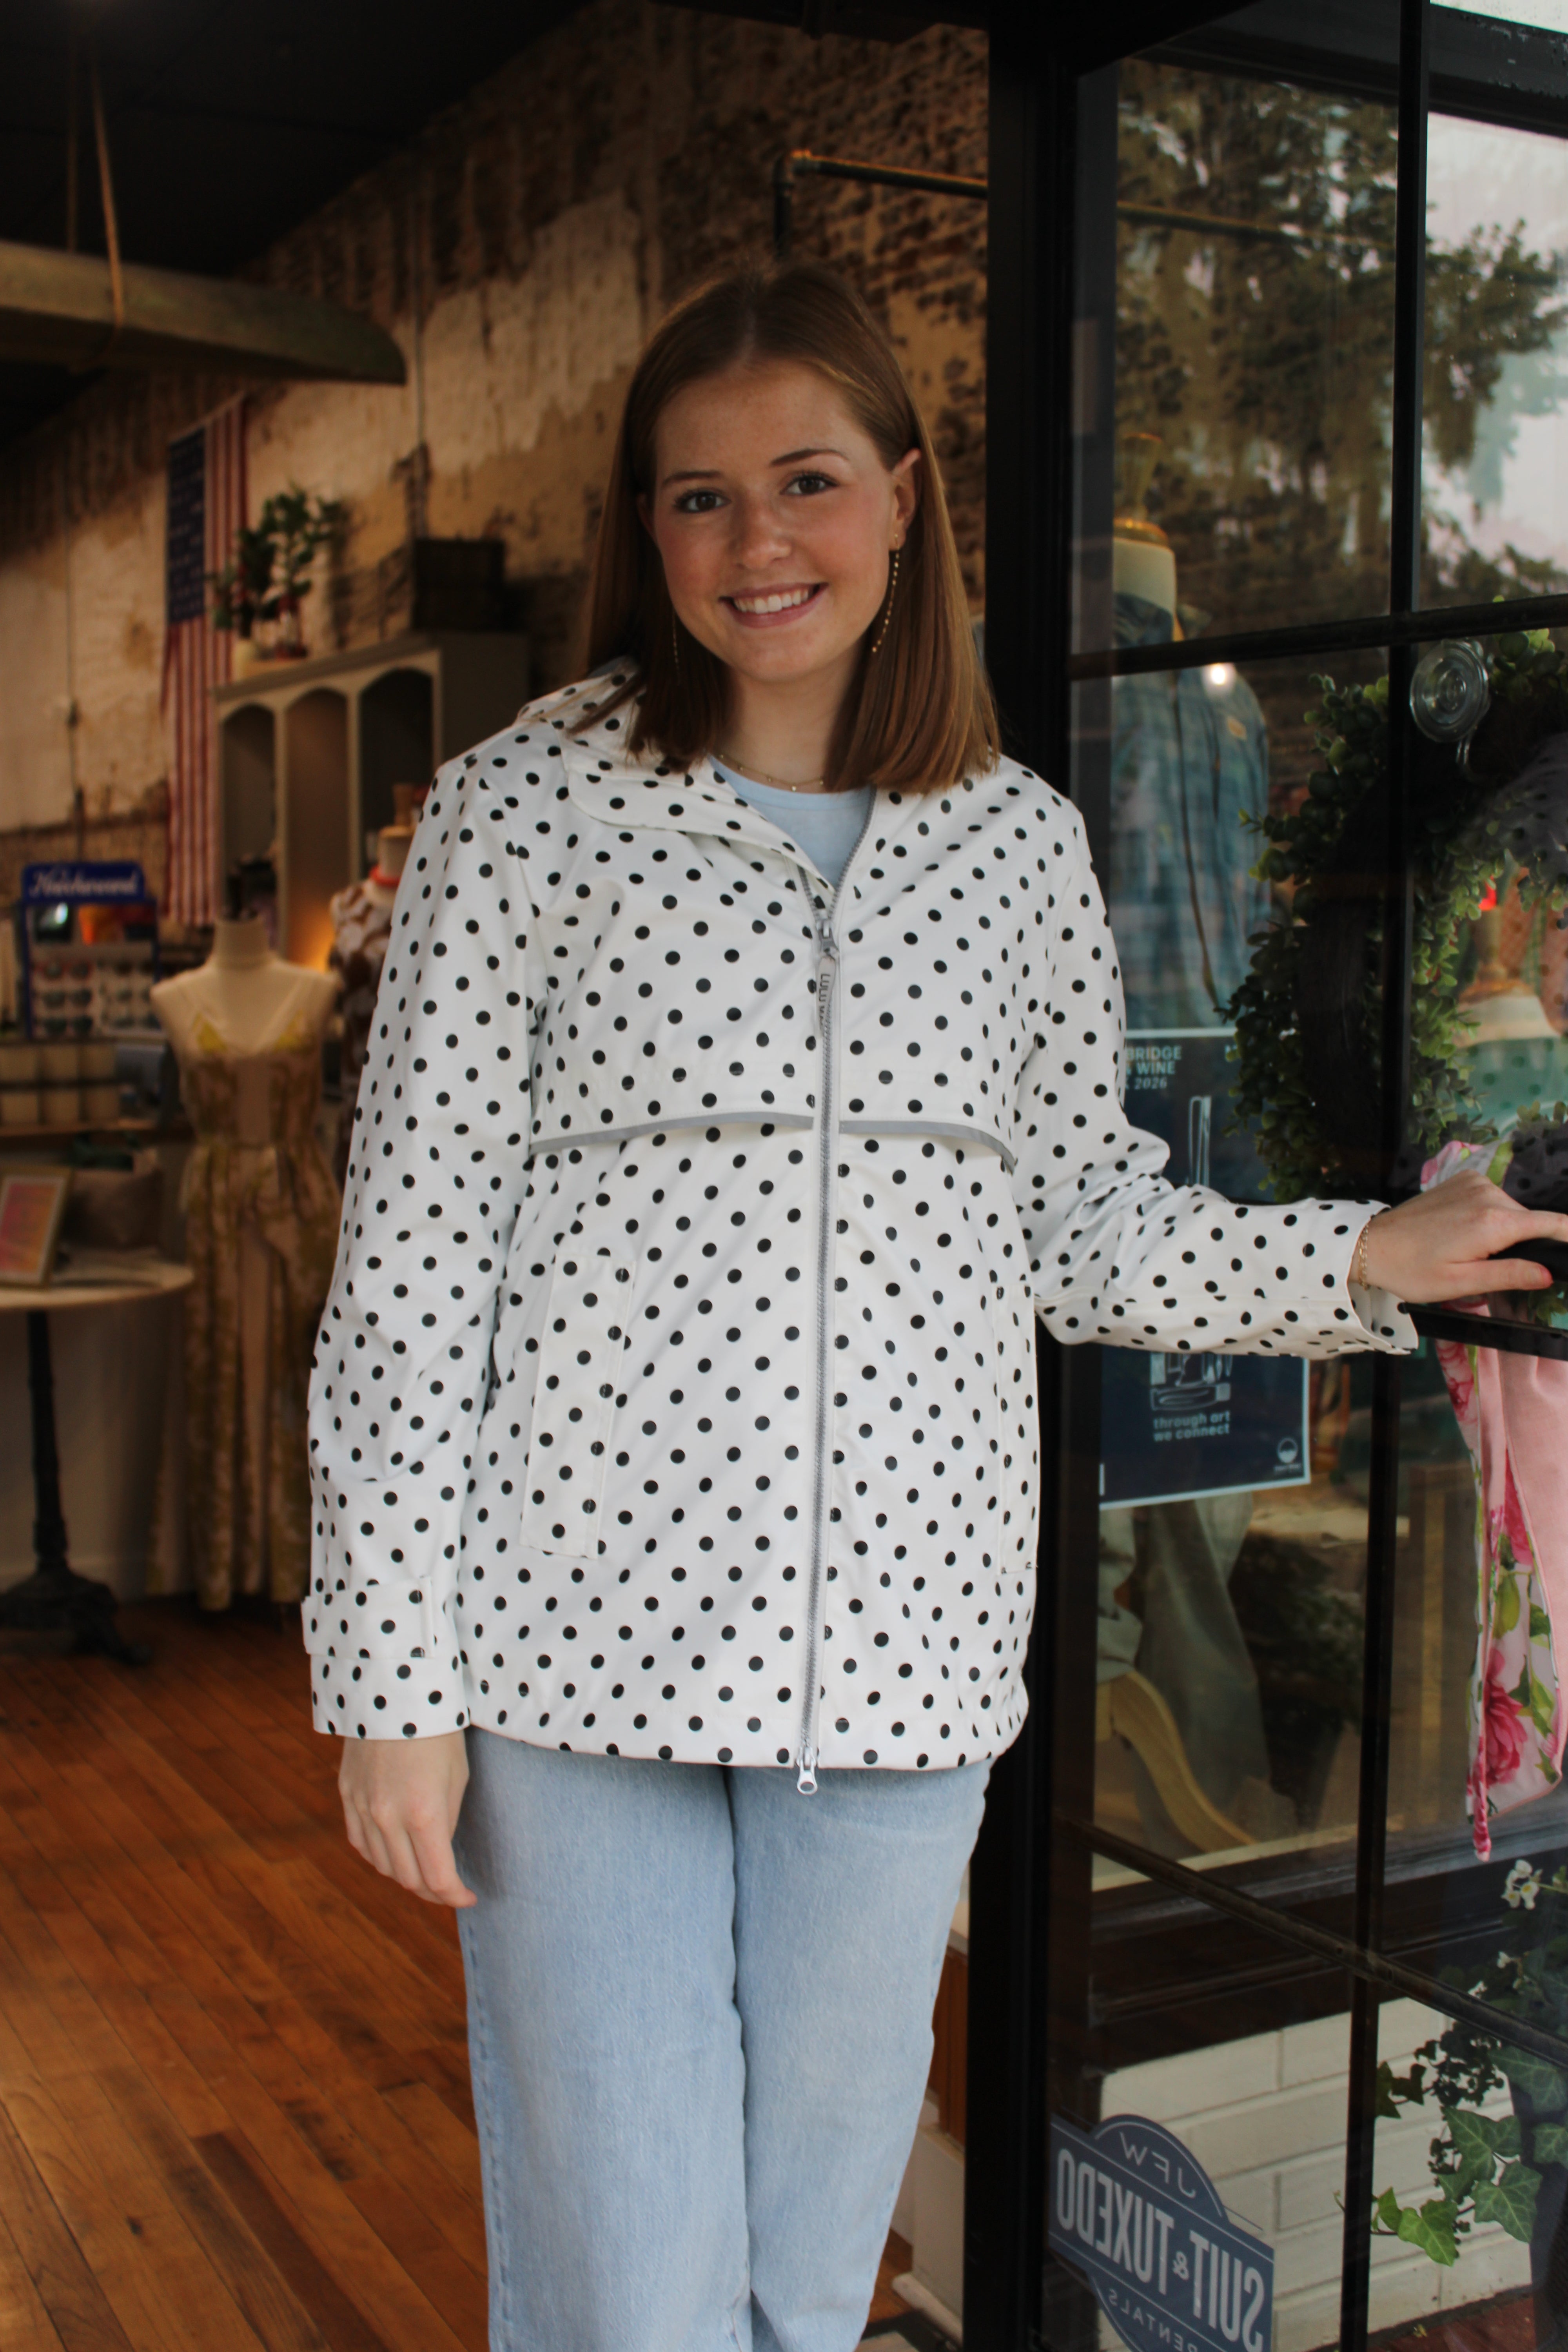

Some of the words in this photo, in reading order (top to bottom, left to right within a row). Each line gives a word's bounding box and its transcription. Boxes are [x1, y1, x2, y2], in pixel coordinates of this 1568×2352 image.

[819, 974, 831, 1002] LULU
[1137, 1061, 1176, 1074] WINE
[1134, 1077, 1167, 1090] 2026
[1154, 1413, 1207, 1429] through
[1210, 1410, 1230, 1423] art
[1154, 1432, 1172, 1441] we
[1176, 1423, 1229, 1439] connect
